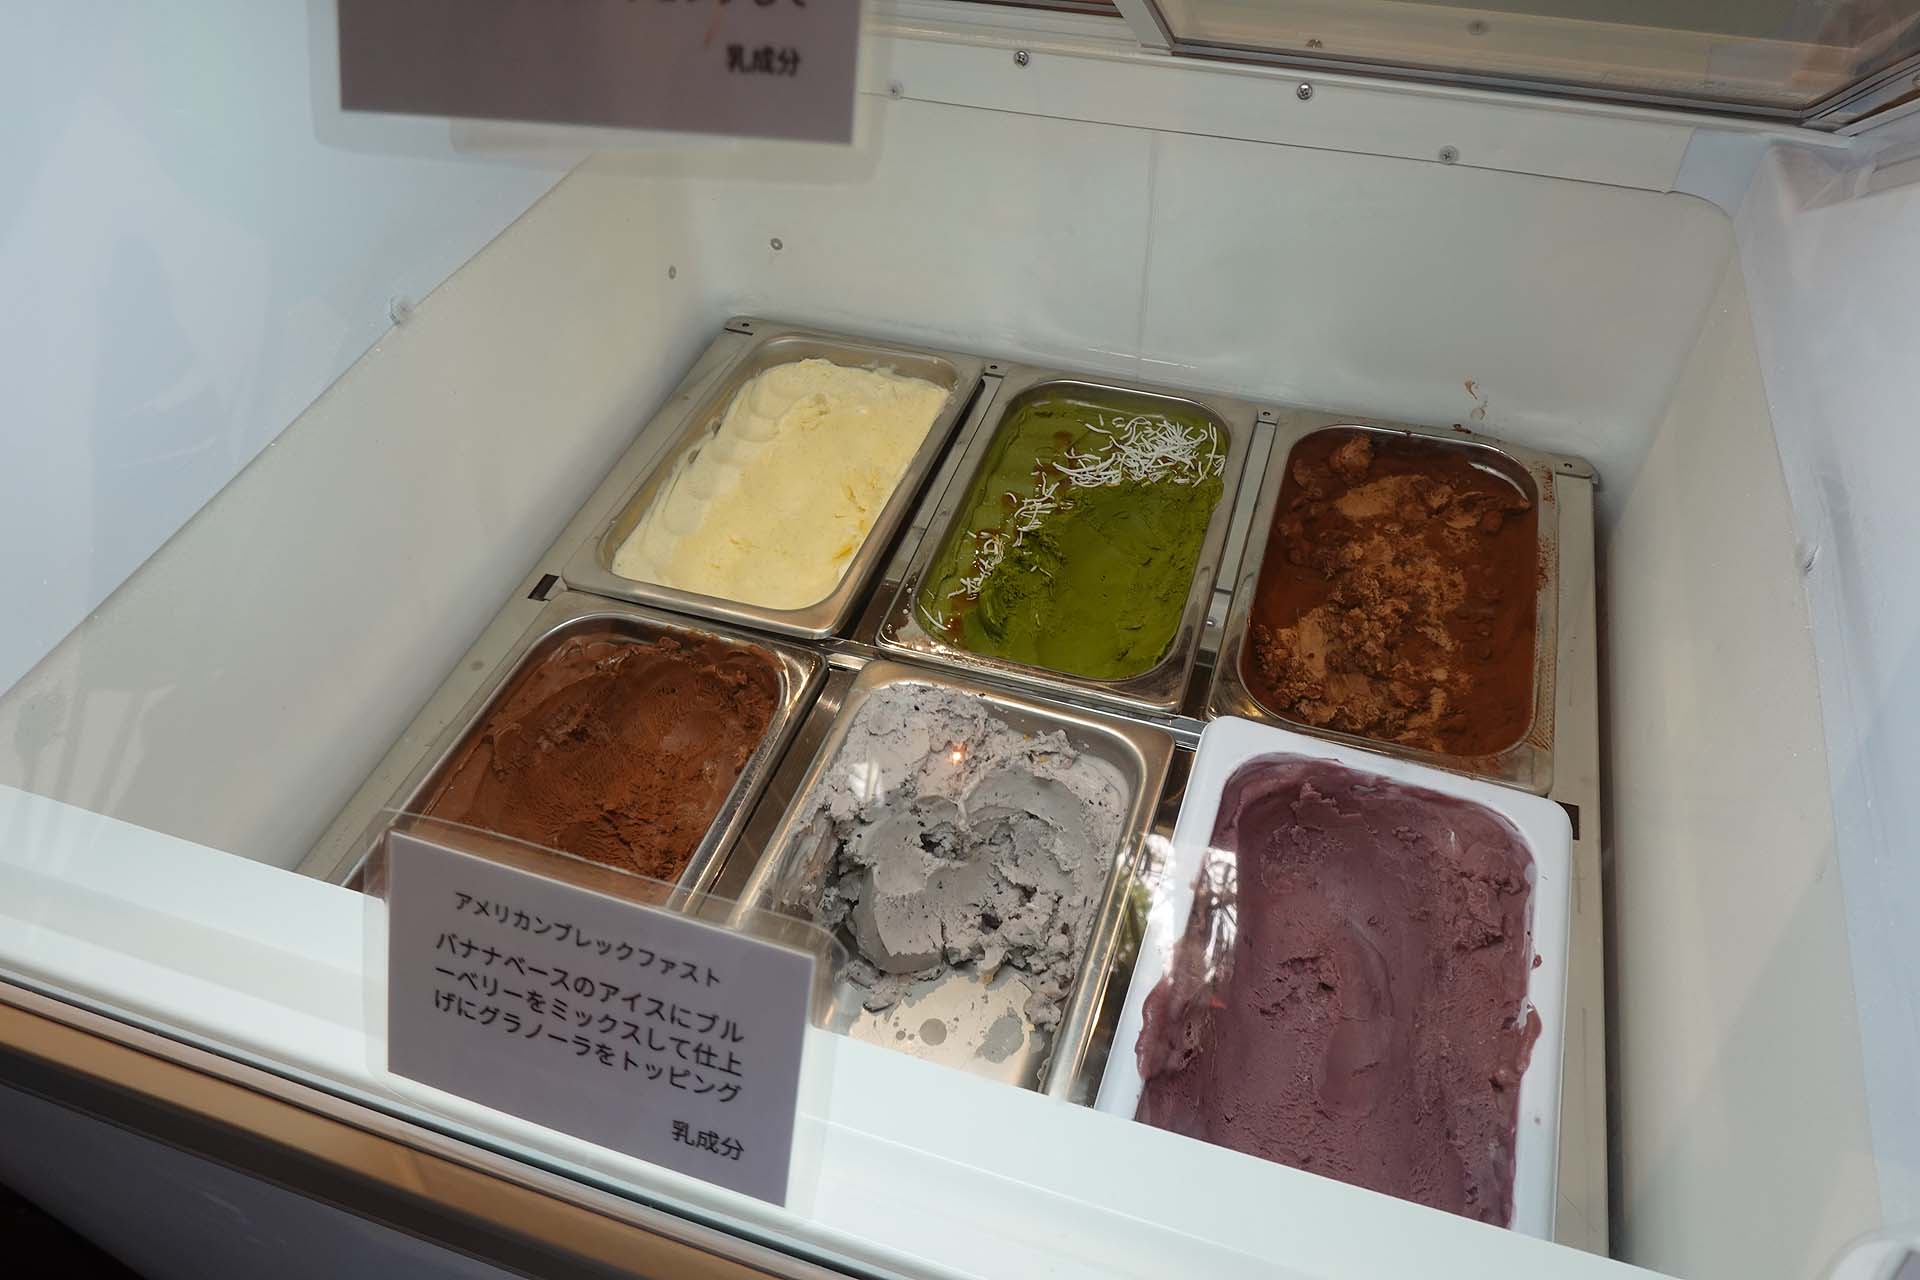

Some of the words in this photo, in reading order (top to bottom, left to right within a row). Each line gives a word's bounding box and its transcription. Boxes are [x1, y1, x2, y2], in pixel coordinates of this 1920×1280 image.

[435, 932, 744, 1043] バナナベースのアイスにブル
[455, 891, 720, 987] アメリカンブレックファスト
[434, 989, 742, 1103] げにグラノーラをトッピング
[435, 966, 743, 1077] ーベリーをミックスして仕上
[671, 1120, 745, 1161] 乳成分
